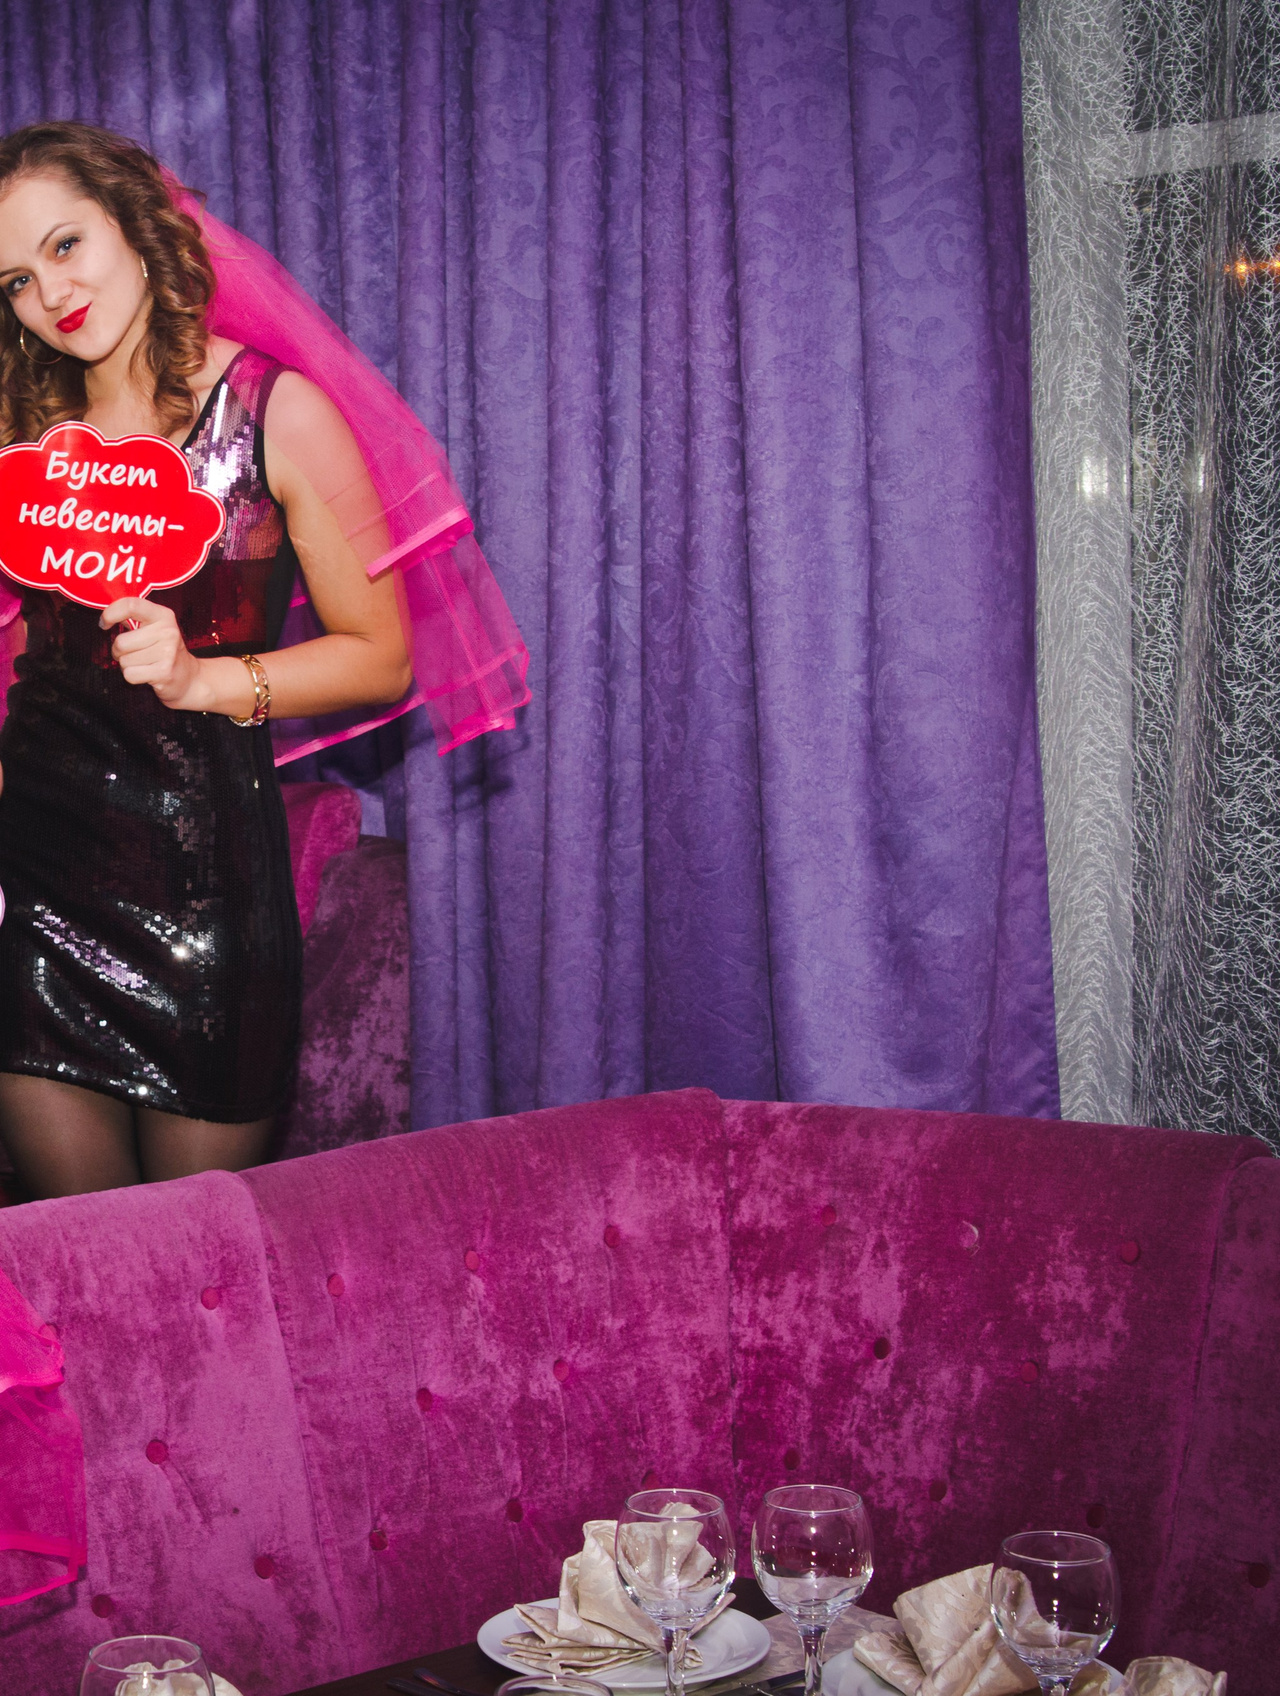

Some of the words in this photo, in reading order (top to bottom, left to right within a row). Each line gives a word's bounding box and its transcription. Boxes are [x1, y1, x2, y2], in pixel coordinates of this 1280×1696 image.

[45, 450, 158, 490] Букет
[18, 497, 185, 537] невесты-
[40, 544, 147, 584] МОЙ!
